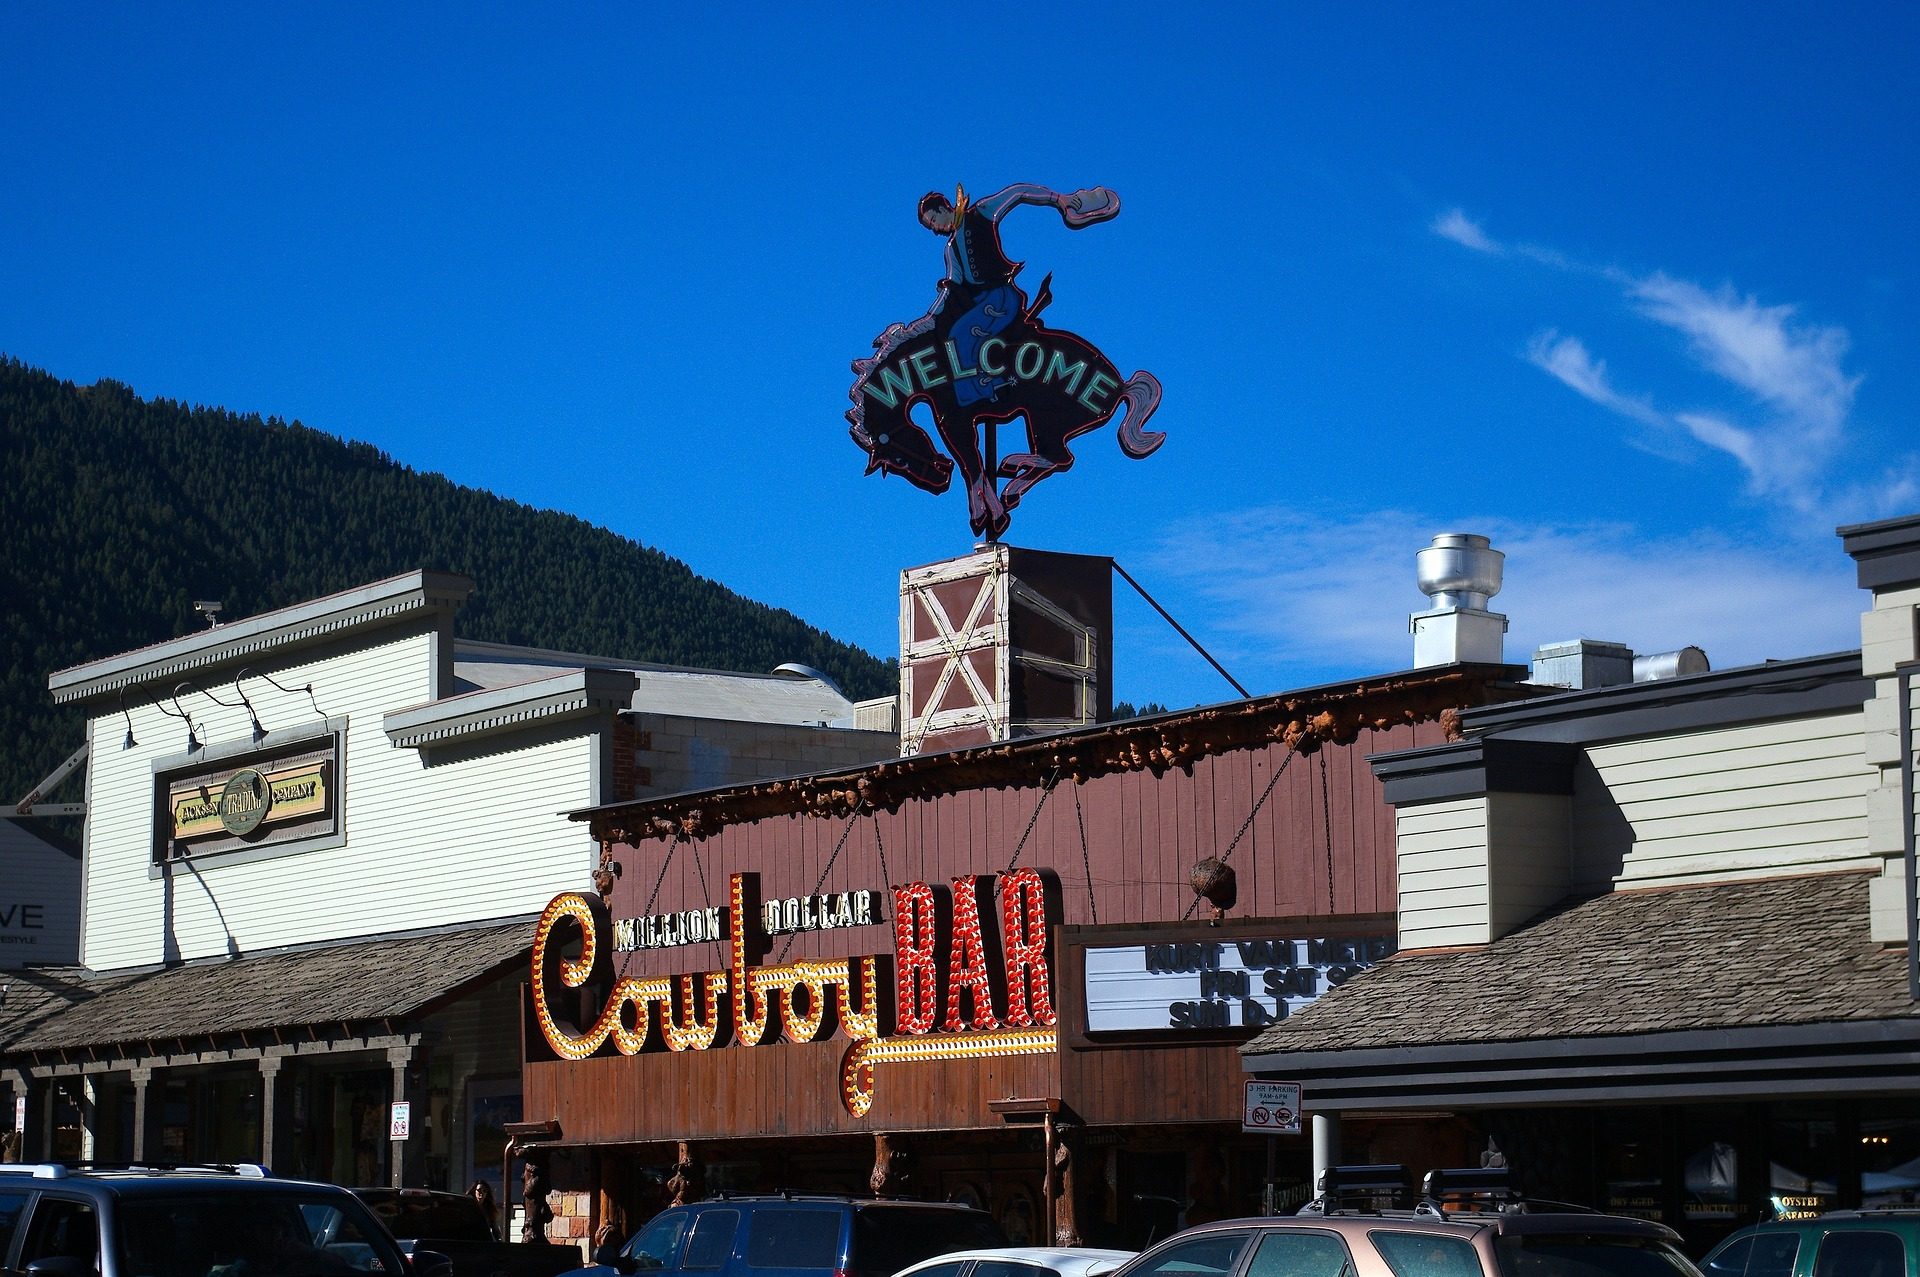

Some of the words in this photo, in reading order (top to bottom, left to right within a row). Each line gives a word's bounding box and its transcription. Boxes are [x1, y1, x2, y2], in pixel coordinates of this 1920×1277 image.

[861, 338, 1119, 415] WELCOME
[181, 801, 220, 821] JACKSON
[226, 789, 262, 816] TRADING
[272, 781, 316, 802] COMPANY
[614, 906, 720, 952] MILLION
[764, 889, 873, 935] DOLLAR
[531, 872, 880, 1118] Cowboy
[890, 867, 1057, 1036] BAR
[1201, 970, 1251, 1000] FRI
[1264, 968, 1322, 998] SAT
[1169, 1000, 1231, 1028] SUN
[1256, 1085, 1266, 1093] HR
[1268, 1085, 1298, 1094] PARKING
